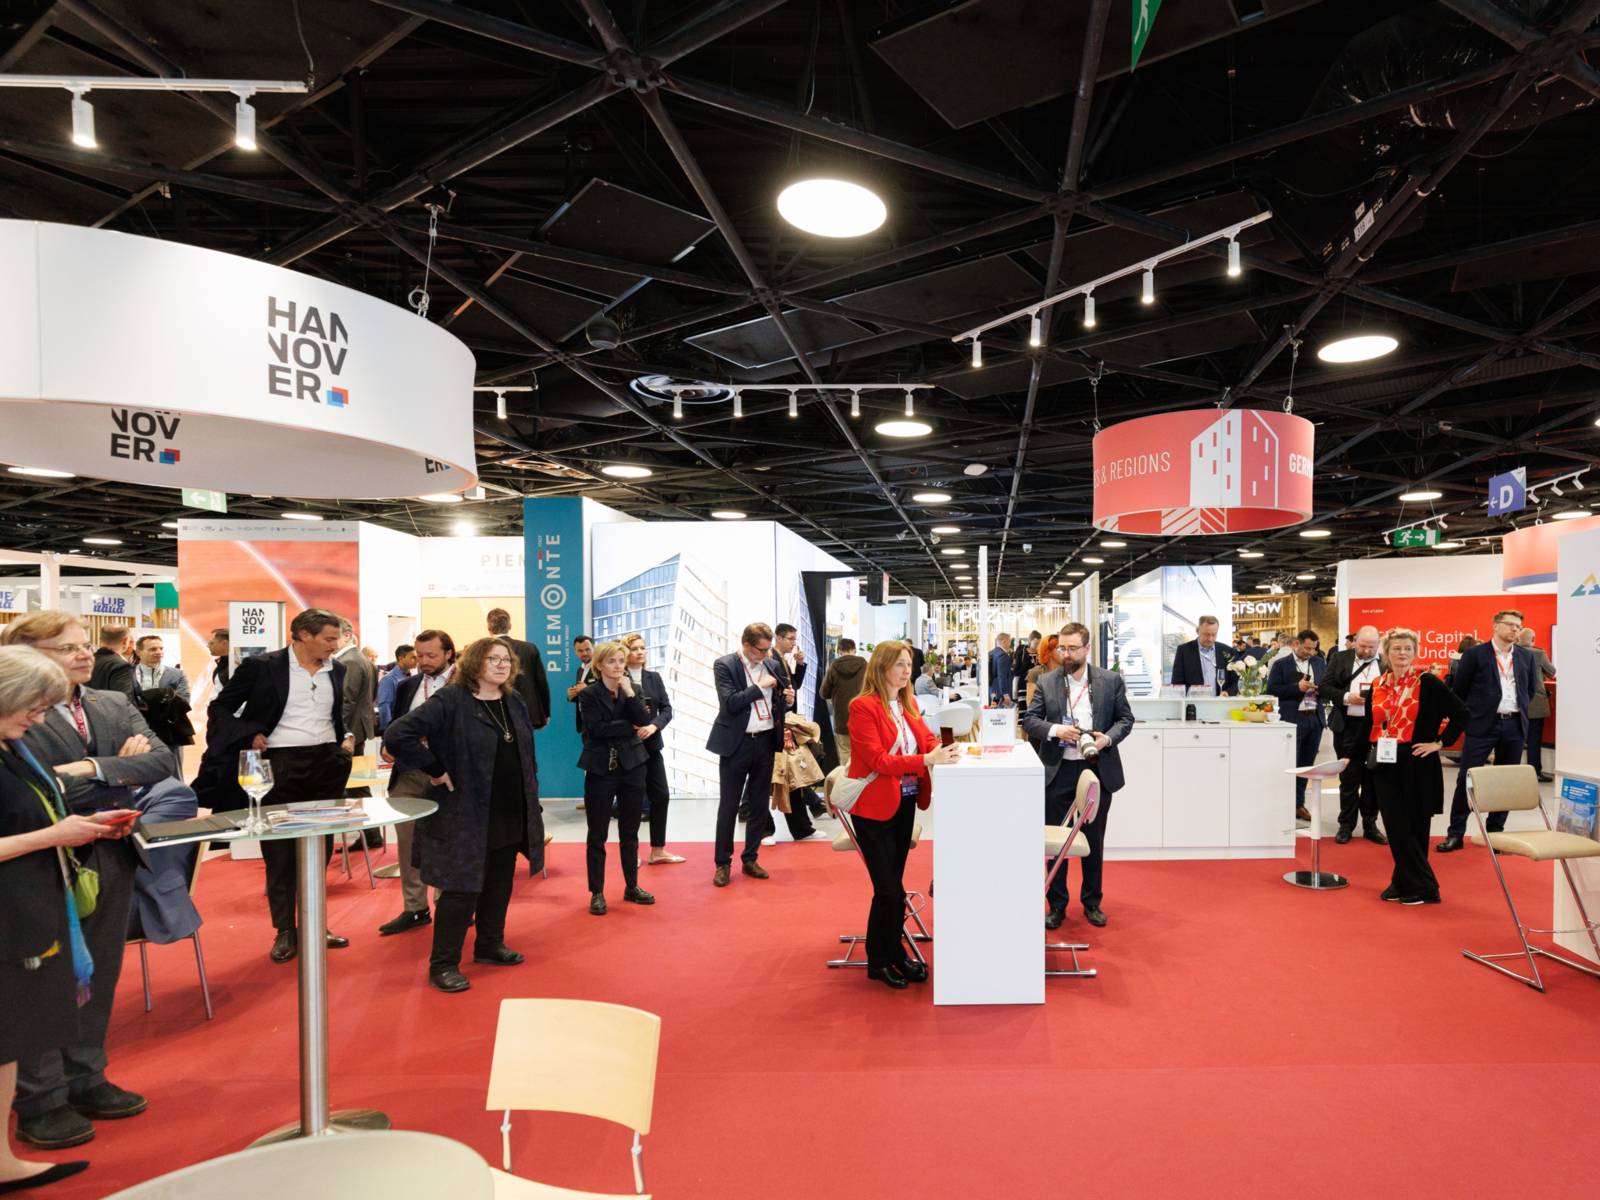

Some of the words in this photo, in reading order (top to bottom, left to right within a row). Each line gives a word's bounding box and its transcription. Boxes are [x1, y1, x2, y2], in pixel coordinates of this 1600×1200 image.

[268, 296, 348, 345] HAN
[268, 332, 348, 376] NOV
[268, 364, 321, 403] ER
[111, 408, 181, 440] NOV
[111, 433, 155, 462] ER
[1101, 465, 1107, 484] &
[1110, 452, 1171, 480] REGIONS
[1500, 485, 1513, 510] D
[242, 608, 265, 617] HAN
[544, 534, 564, 672] PIEMONTE
[242, 617, 265, 626] NOV
[242, 626, 257, 634] ER
